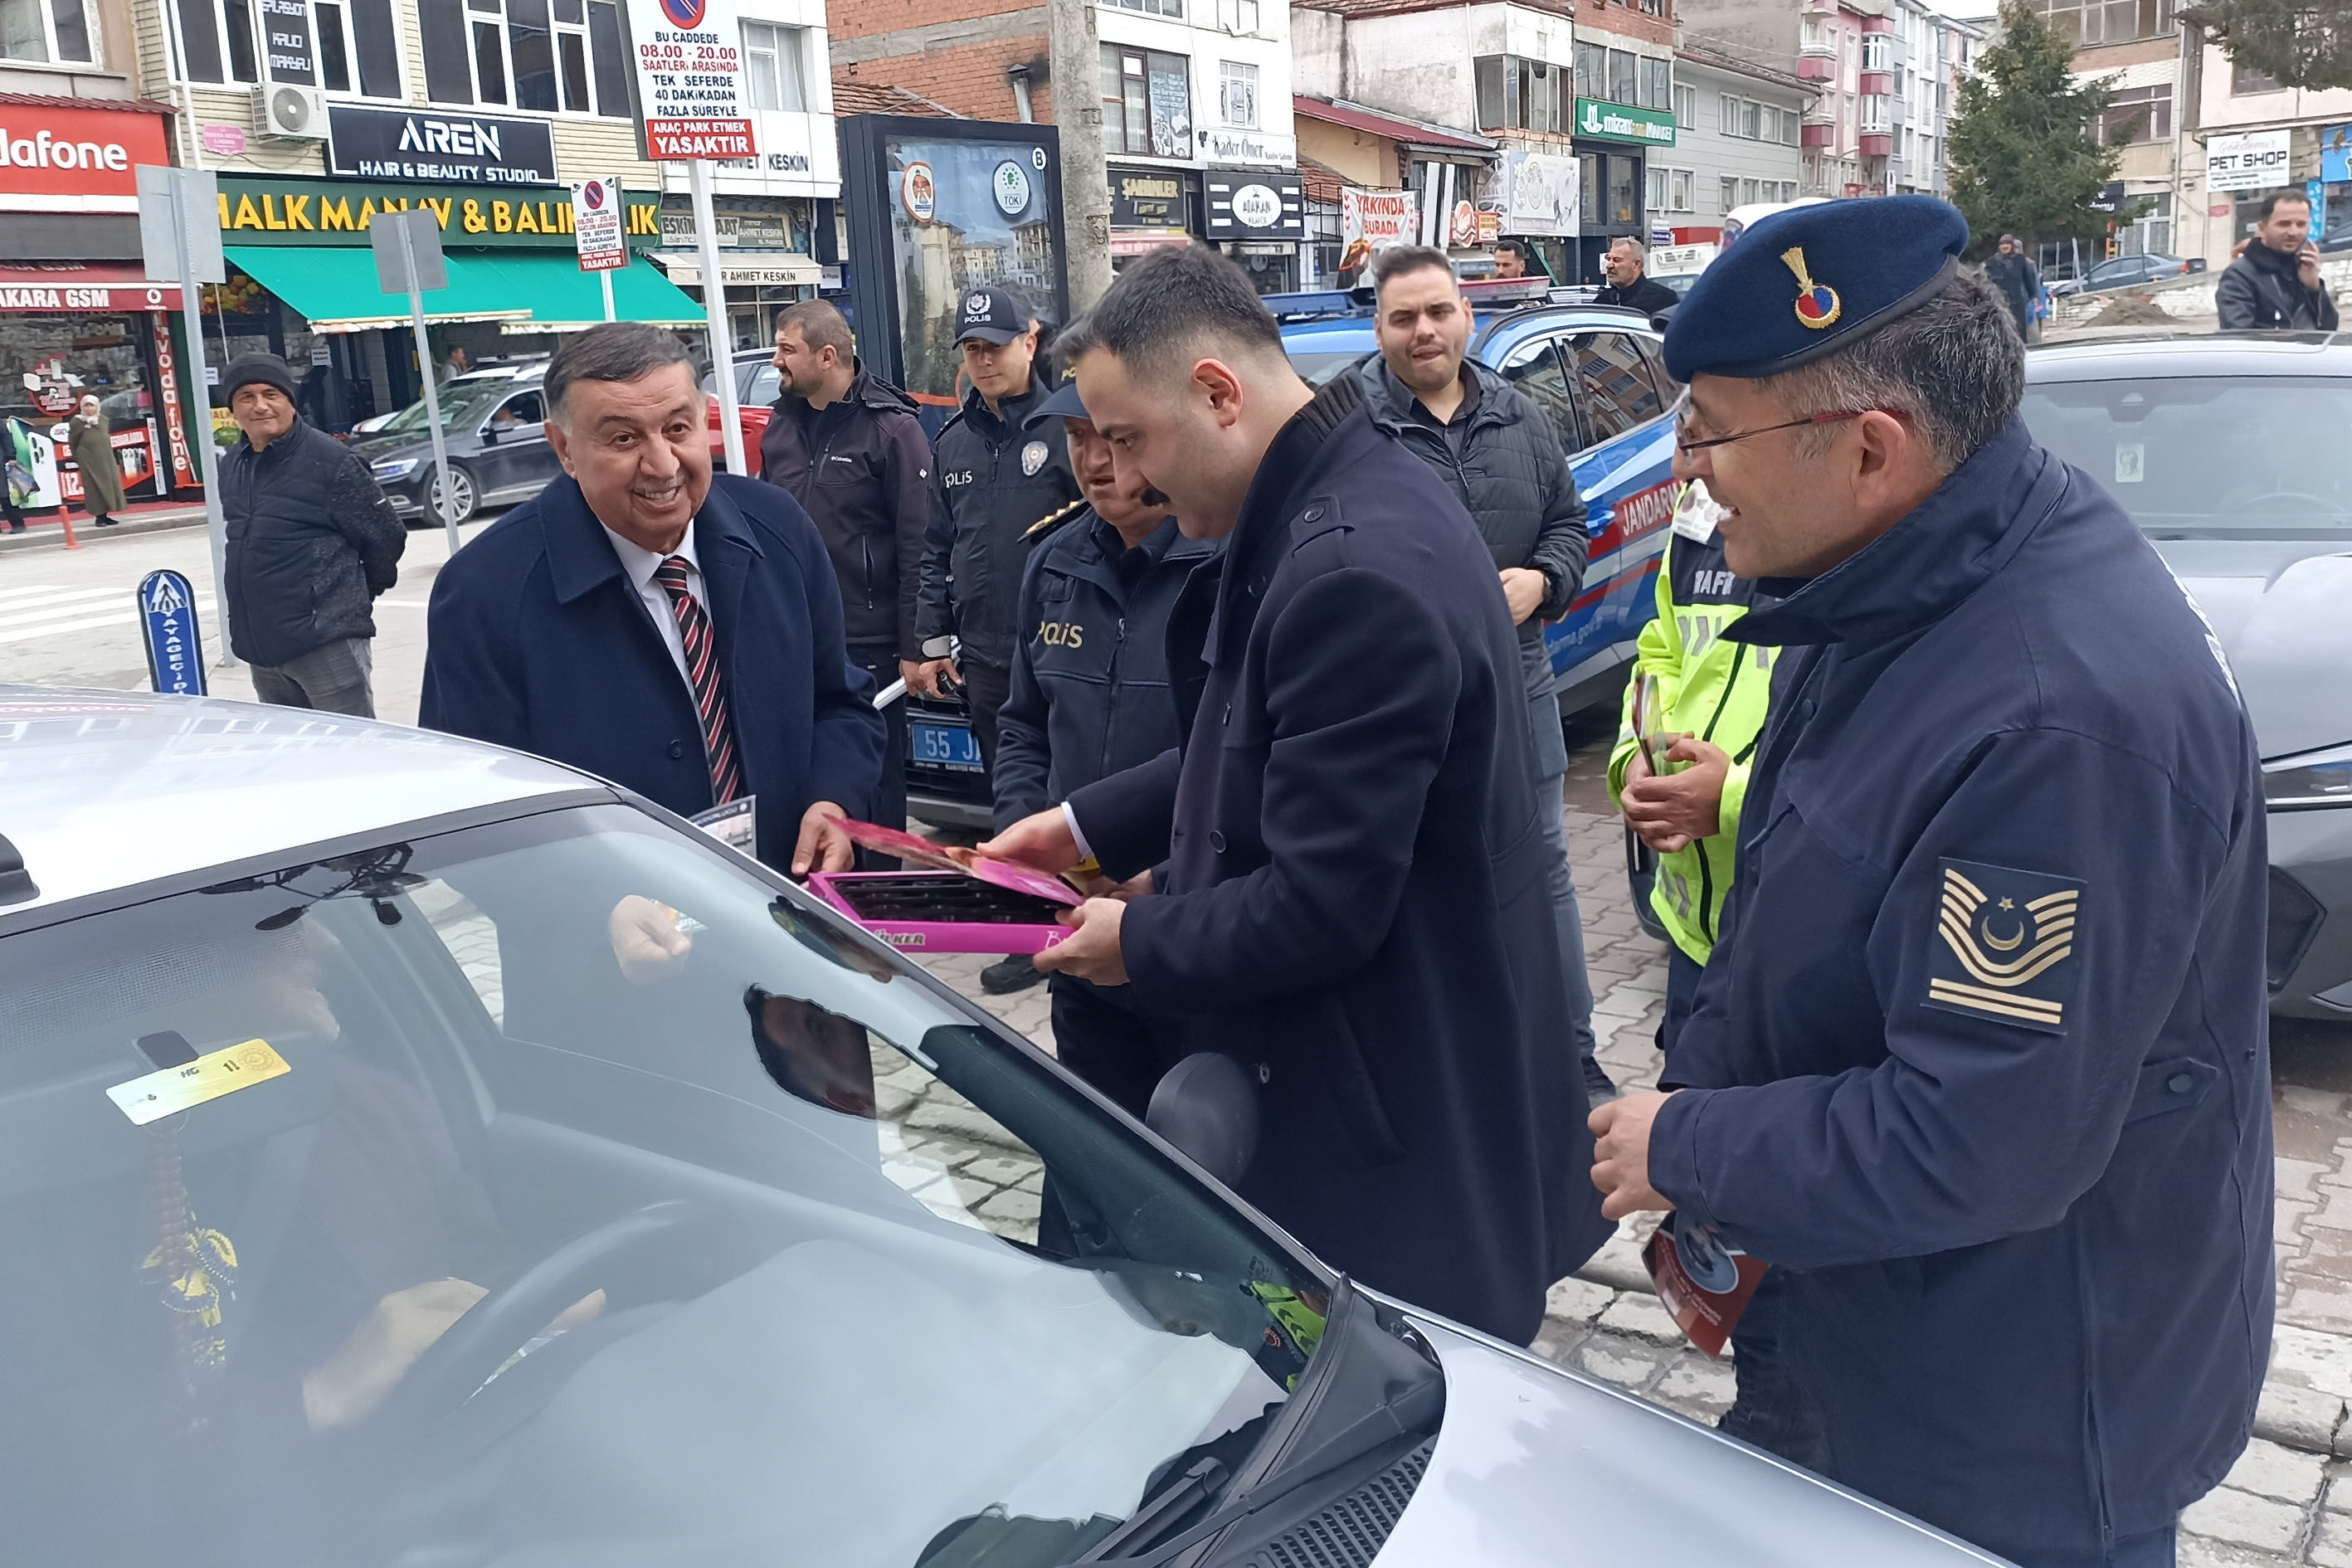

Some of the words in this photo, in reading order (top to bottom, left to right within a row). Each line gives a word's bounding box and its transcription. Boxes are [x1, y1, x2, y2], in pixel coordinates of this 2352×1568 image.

[655, 32, 669, 42] BU
[673, 32, 719, 44] CADDEDE
[640, 45, 682, 58] 08.00
[697, 46, 737, 60] 20.00
[653, 75, 675, 85] TEK
[684, 75, 733, 87] SEFERDE
[655, 90, 668, 100] 40
[657, 106, 689, 116] FAZLA
[693, 104, 738, 116] SÜREYLE
[654, 122, 681, 135] ARAÇ
[684, 122, 710, 133] PARK
[713, 122, 746, 133] ETMEK
[399, 117, 502, 162] AREN
[655, 136, 749, 154] YASAKTIR
[2208, 155, 2238, 171] PET
[2242, 150, 2287, 168] SHOP
[360, 161, 399, 176] HAIR
[403, 163, 414, 177] &
[417, 163, 479, 180] BEAUTY
[486, 168, 539, 183] STUDIO
[1356, 196, 1405, 217] YAKINDA
[464, 198, 488, 233] &
[1364, 219, 1400, 235] BURADA
[582, 256, 621, 269] YASAKTIR
[731, 271, 760, 281] AHMET
[66, 290, 110, 308] GSM
[925, 730, 951, 758] 55
